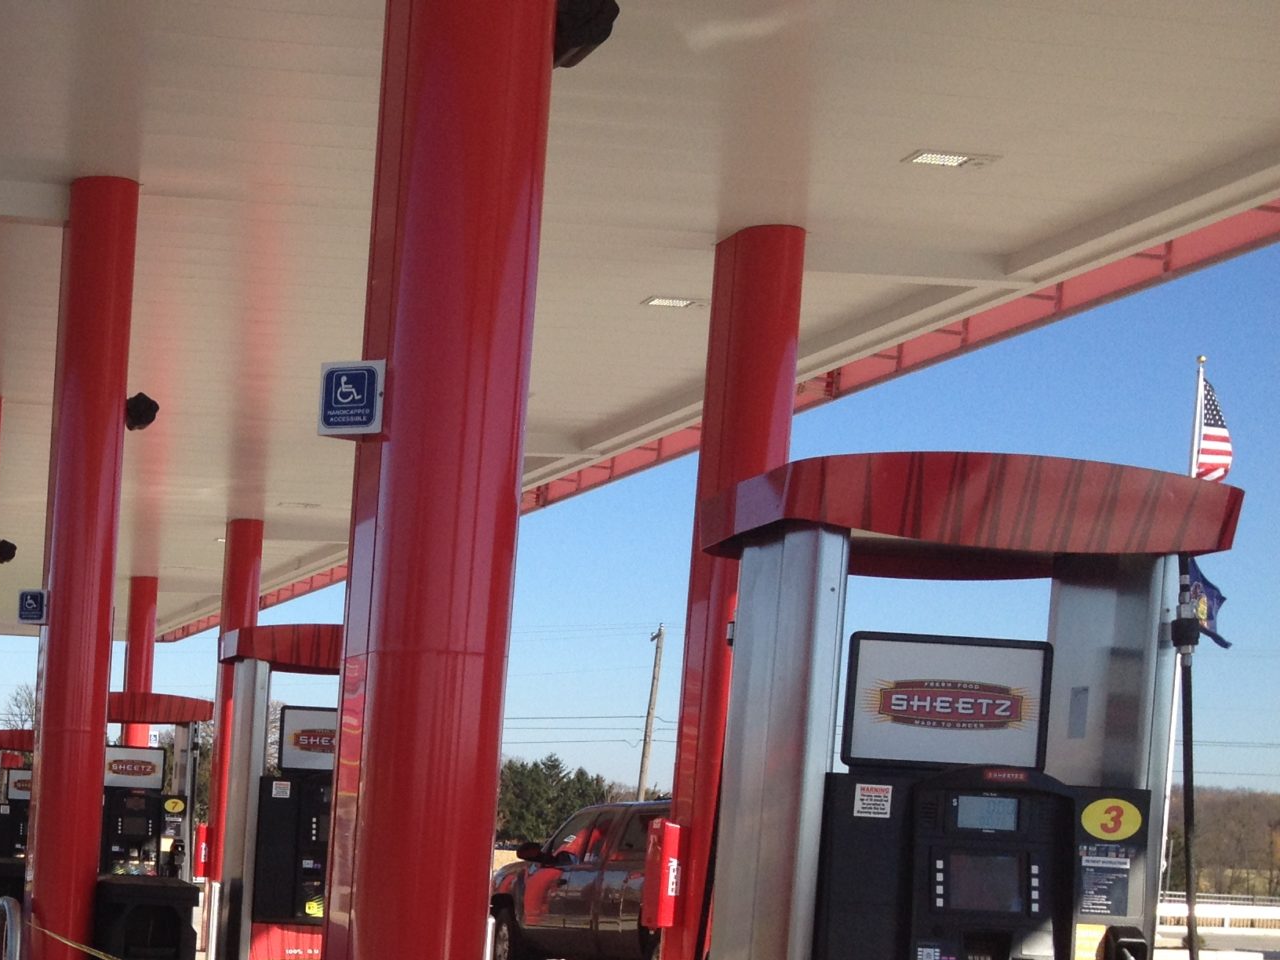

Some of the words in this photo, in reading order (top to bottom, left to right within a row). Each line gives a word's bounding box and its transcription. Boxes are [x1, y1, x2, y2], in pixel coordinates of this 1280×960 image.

[957, 682, 980, 690] FOOD
[891, 694, 1012, 717] SHEETZ
[299, 736, 336, 745] SHE
[111, 764, 152, 772] SHEETZ
[171, 801, 178, 810] 7
[1101, 806, 1124, 833] 3
